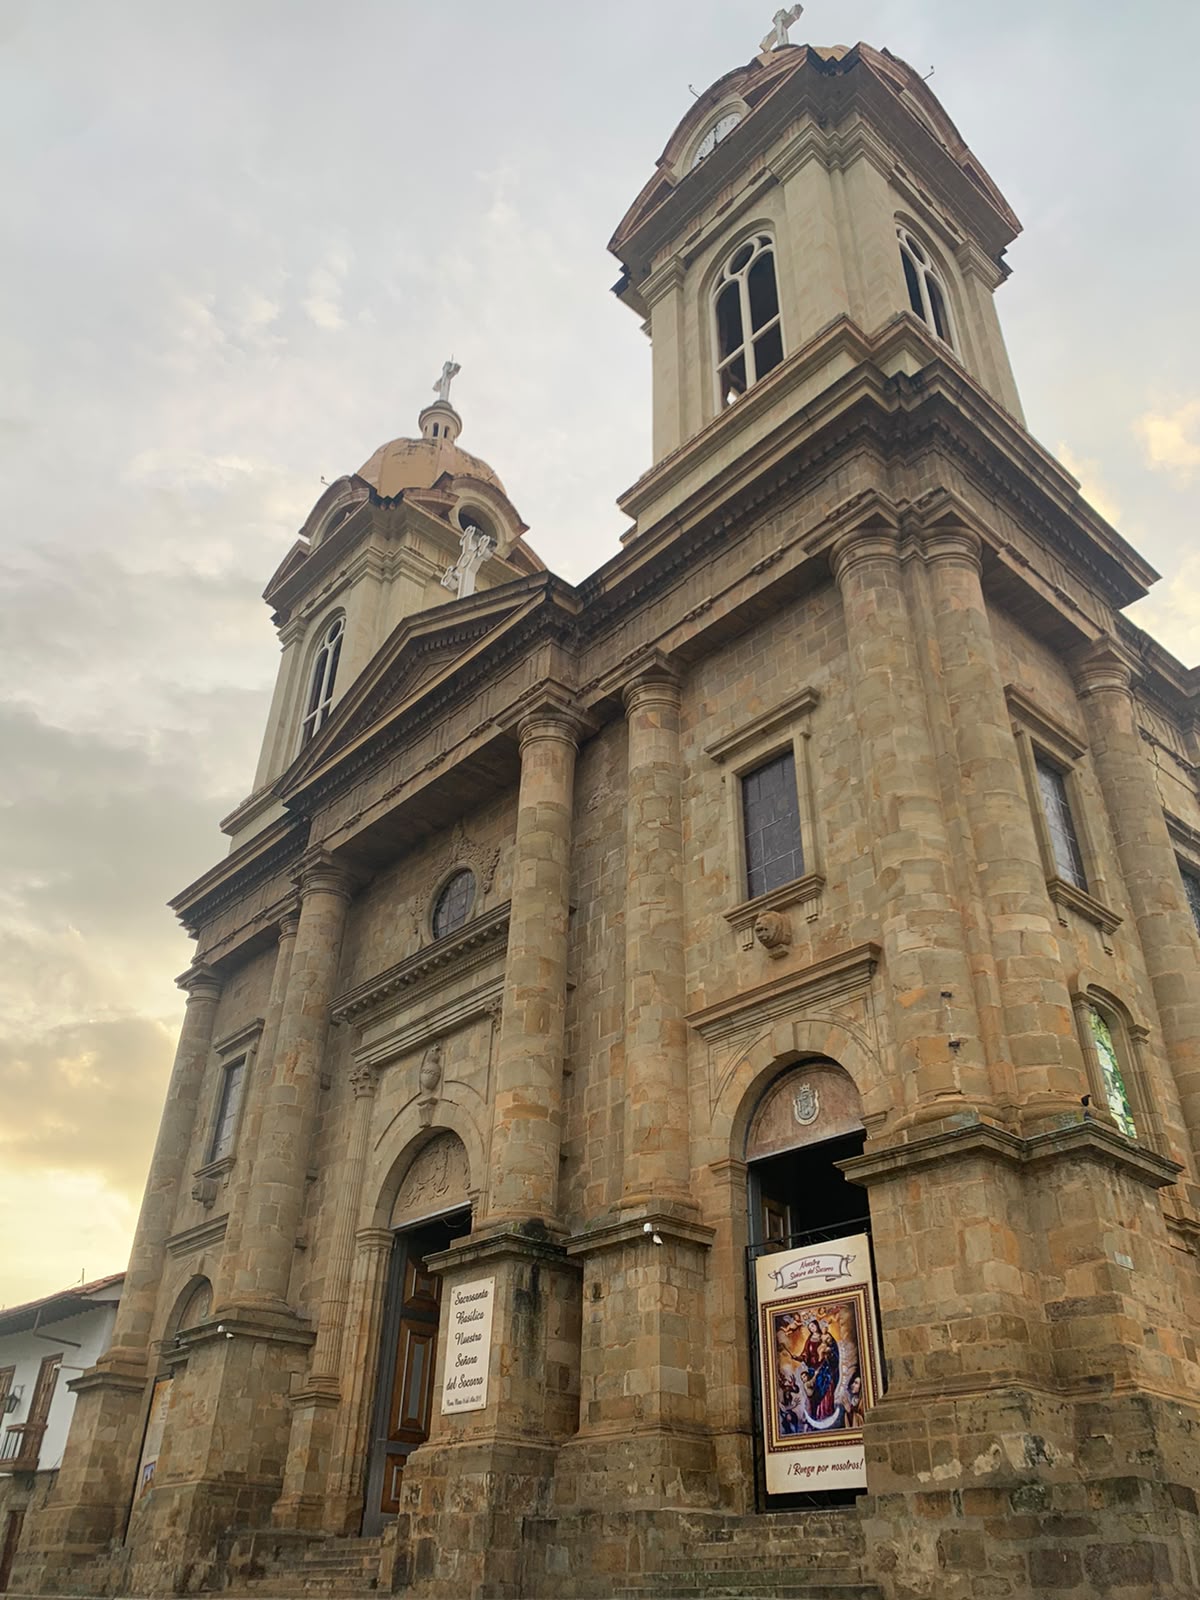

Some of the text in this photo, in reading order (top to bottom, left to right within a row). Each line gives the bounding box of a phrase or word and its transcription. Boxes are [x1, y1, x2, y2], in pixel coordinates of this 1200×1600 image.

[807, 1266, 815, 1275] del
[815, 1265, 834, 1274] Socorro
[455, 1332, 482, 1345] Nuestra
[455, 1352, 478, 1368] Señora
[446, 1373, 483, 1391] del Socorro
[816, 1463, 829, 1475] por
[831, 1458, 864, 1471] nosotros!
